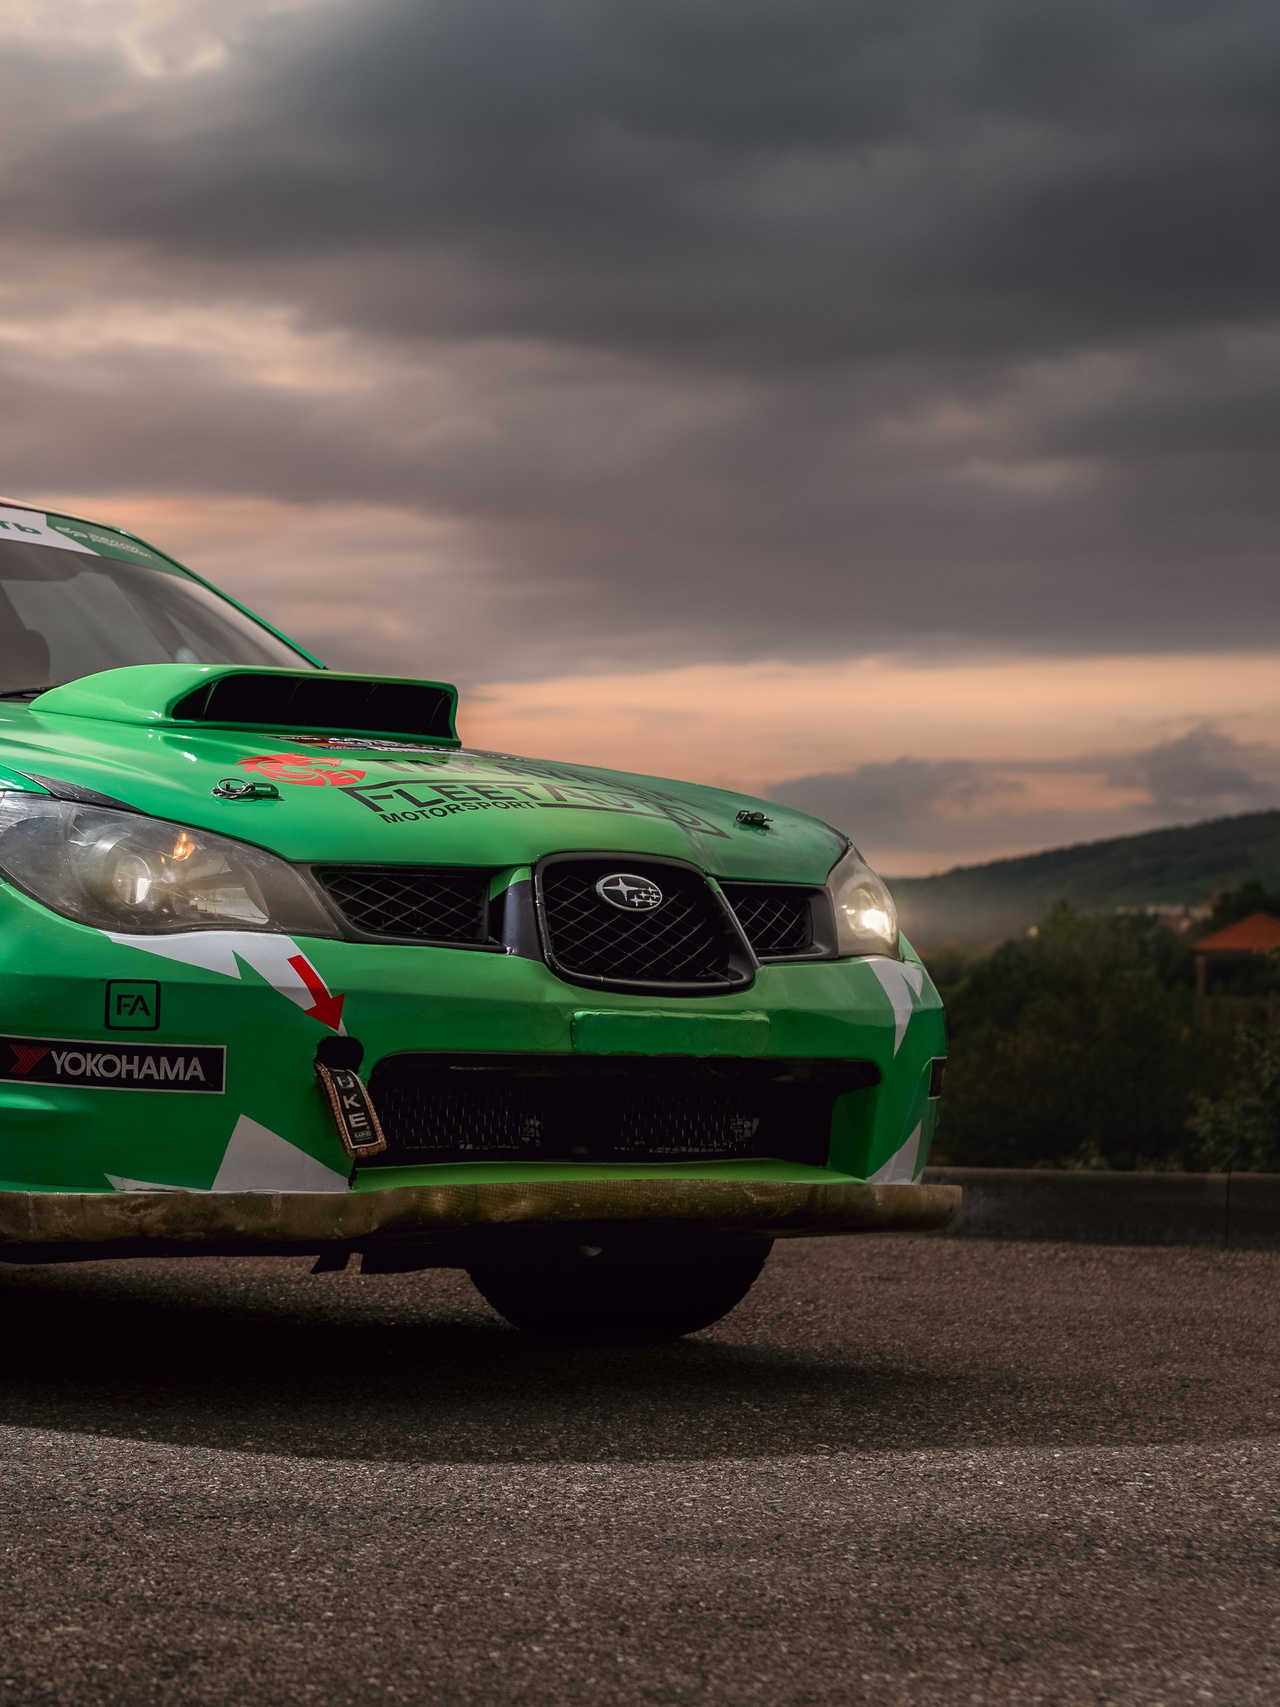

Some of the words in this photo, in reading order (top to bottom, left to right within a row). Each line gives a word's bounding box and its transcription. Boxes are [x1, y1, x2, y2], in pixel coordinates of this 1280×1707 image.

[379, 801, 537, 824] MOTORSPORT
[117, 994, 152, 1017] FA
[51, 1049, 206, 1082] YOKOHAMA
